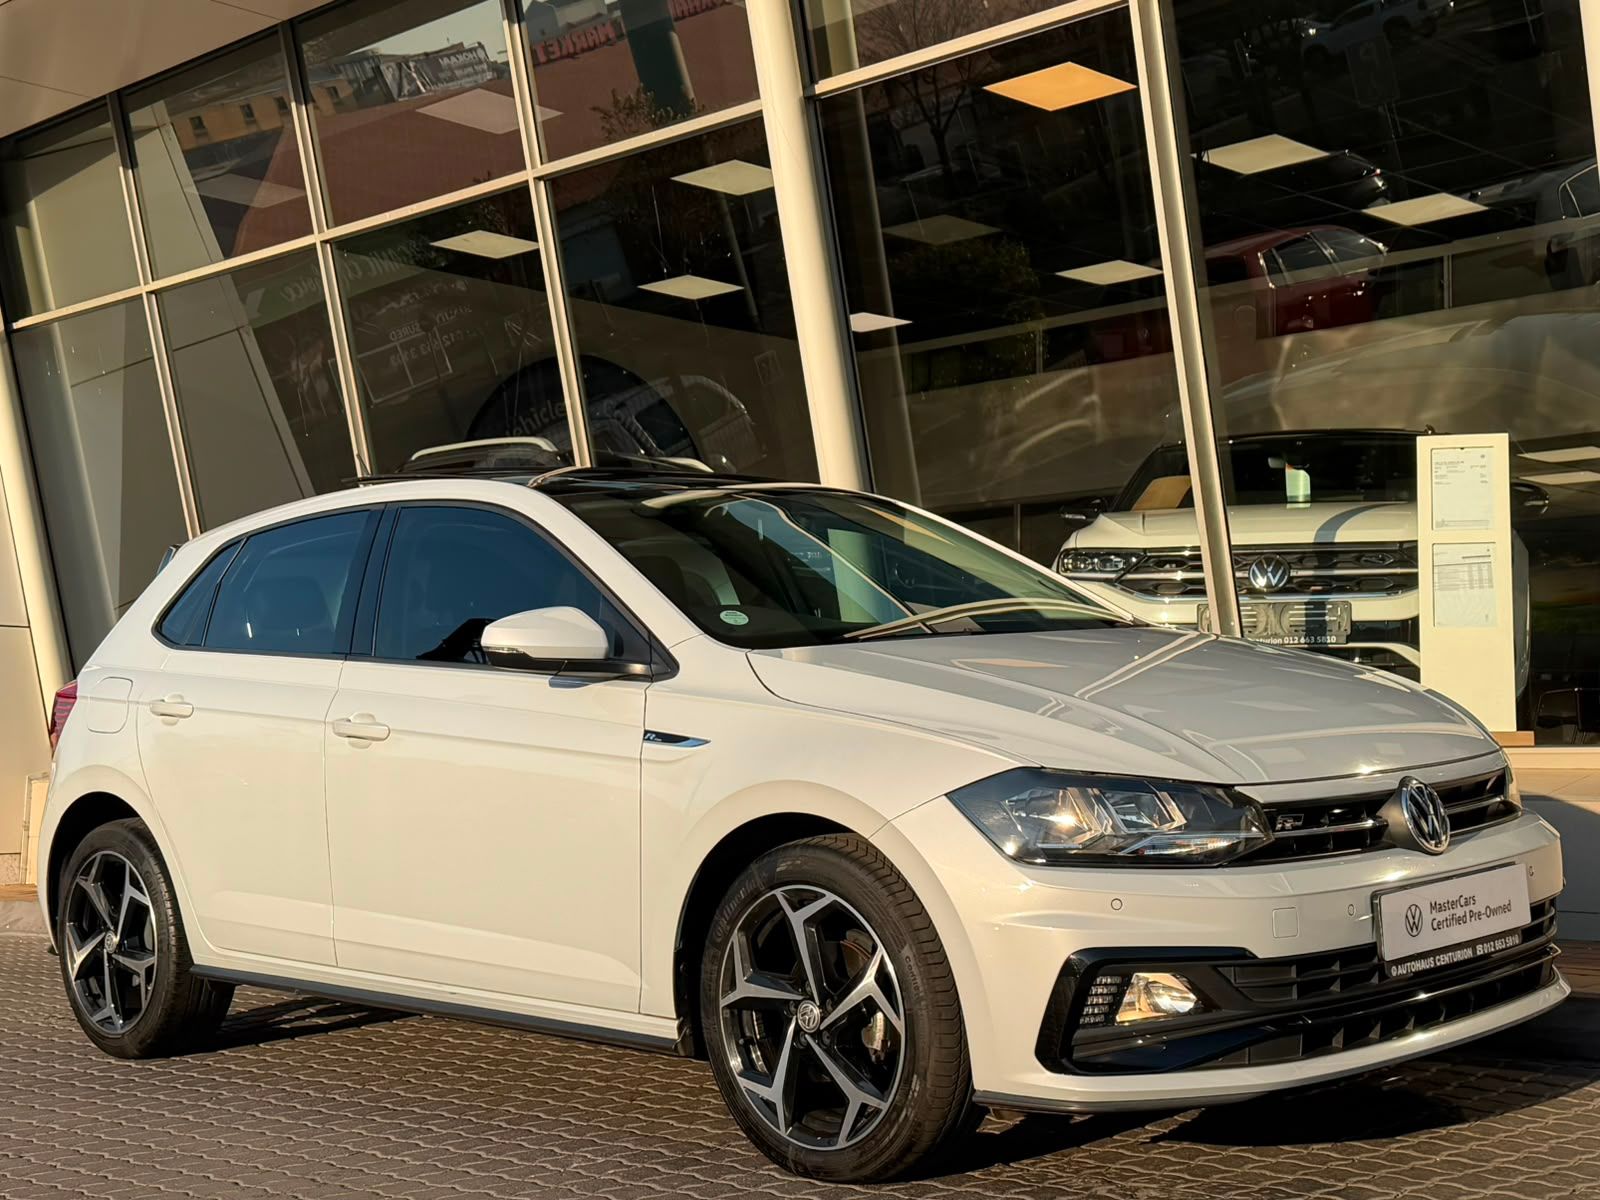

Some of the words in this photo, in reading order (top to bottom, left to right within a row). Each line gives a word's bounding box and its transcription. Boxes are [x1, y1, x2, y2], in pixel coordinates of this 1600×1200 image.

[1429, 894, 1477, 915] MasterCars
[1431, 911, 1467, 932] Certified
[1469, 899, 1512, 923] Pre-Owned
[1435, 947, 1473, 966] CENTURION
[1483, 943, 1495, 954] 012
